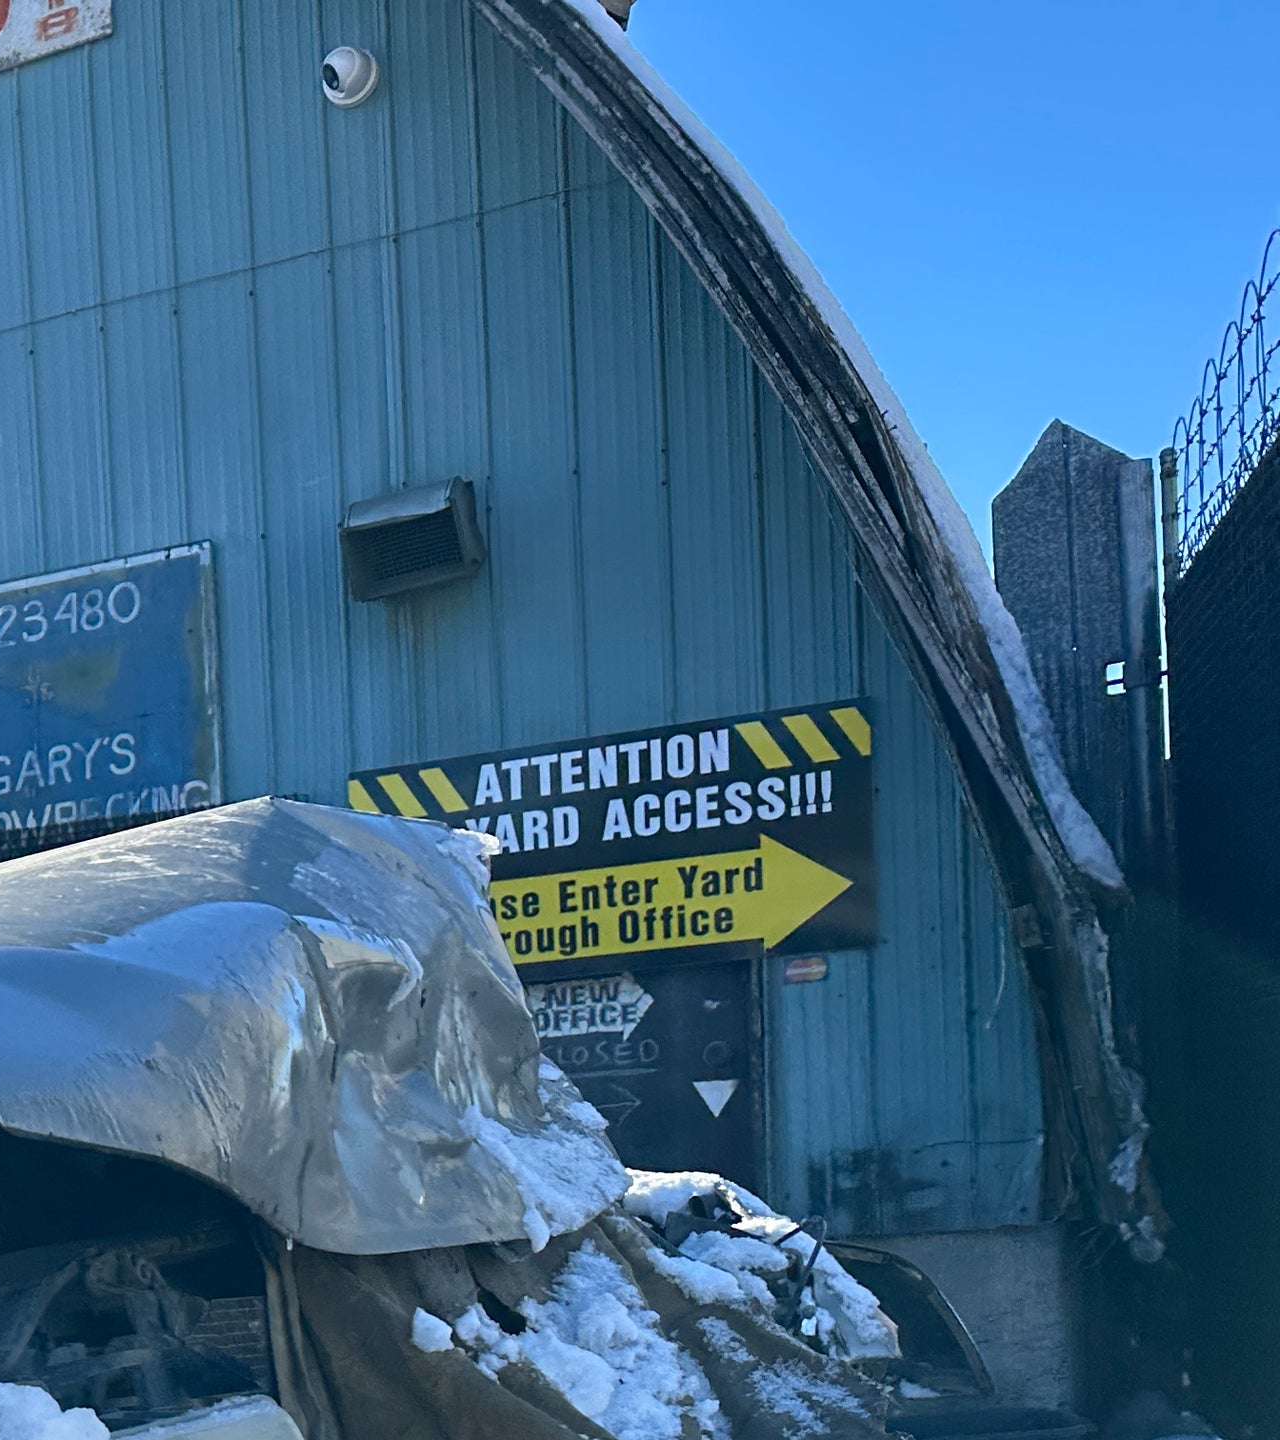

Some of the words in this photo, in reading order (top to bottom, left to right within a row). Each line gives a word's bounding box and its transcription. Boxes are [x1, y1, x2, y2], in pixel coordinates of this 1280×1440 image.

[474, 728, 730, 806] ATTENTION
[601, 770, 833, 842] ACCESS!!!
[558, 875, 659, 914] Enter
[677, 857, 764, 899] Yard
[618, 903, 734, 945] Office
[535, 1003, 639, 1032] OFFICE
[545, 980, 619, 1008] NEW
